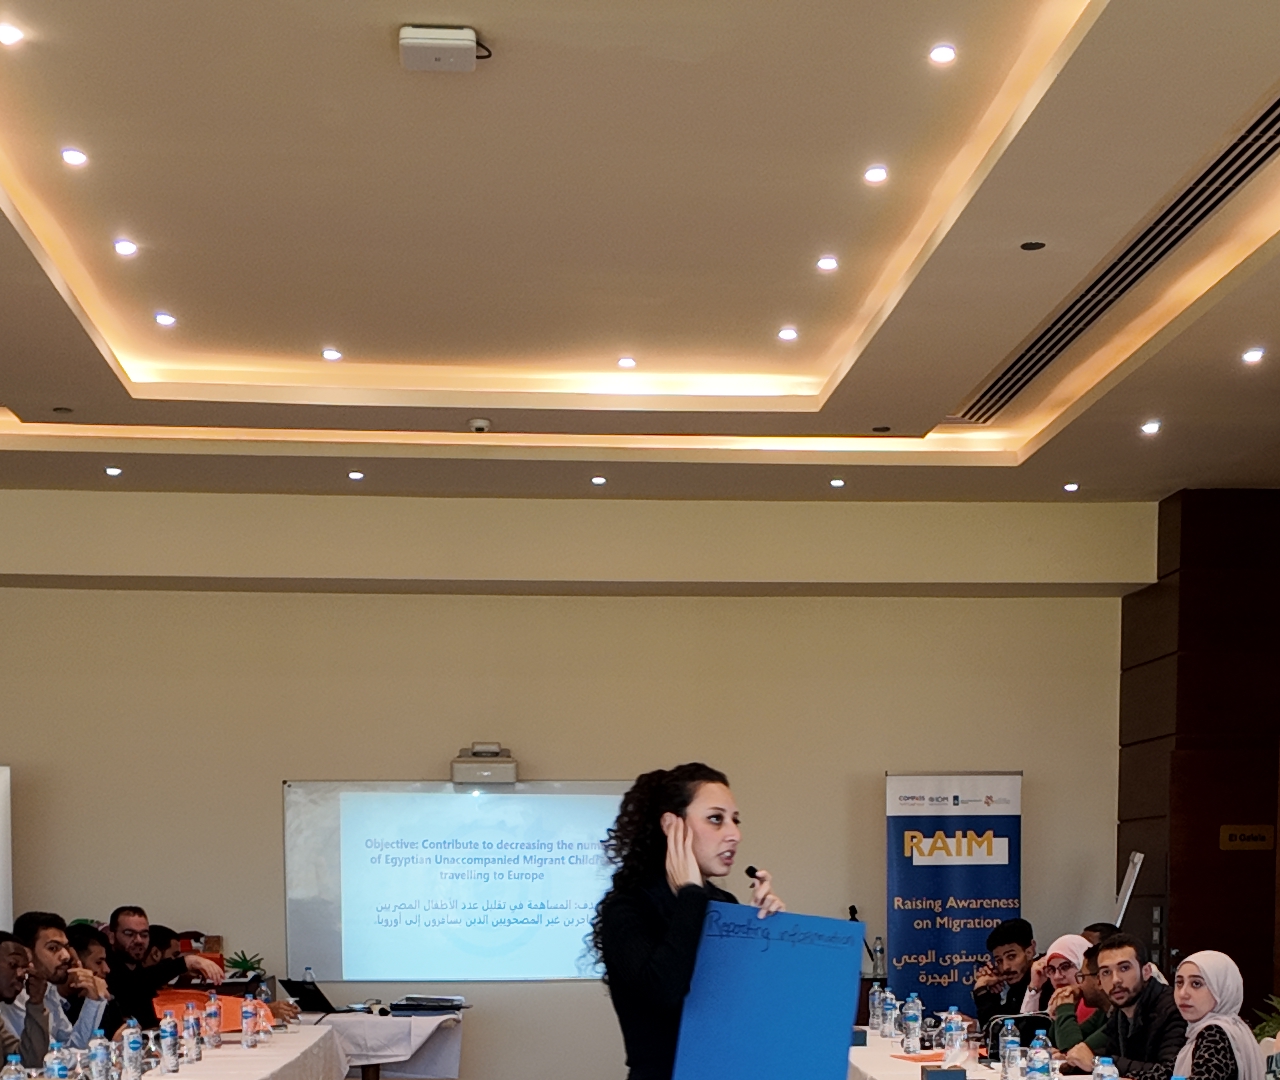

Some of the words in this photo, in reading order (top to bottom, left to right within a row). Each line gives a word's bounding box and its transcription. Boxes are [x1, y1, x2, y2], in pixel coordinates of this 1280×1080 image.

[364, 838, 419, 851] Objective:
[421, 838, 479, 850] Contribute
[482, 840, 494, 850] to
[496, 838, 553, 852] decreasing
[556, 839, 574, 850] the
[904, 830, 994, 858] RAIM
[370, 853, 382, 865] of
[384, 854, 432, 867] Egyptian
[434, 854, 520, 867] Unaccompanied
[523, 855, 566, 867] Migrant
[439, 869, 490, 882] travelling
[493, 871, 505, 880] to
[507, 870, 545, 882] Europe
[375, 899, 420, 913] المصريين
[423, 898, 458, 912] الأطفال
[461, 901, 479, 910] عدد
[482, 899, 507, 912] تقليل
[509, 900, 524, 913] في
[527, 899, 572, 910] المساهمة
[894, 896, 943, 913] Raising
[945, 896, 1020, 910] Awareness
[404, 913, 420, 927] إلى
[423, 913, 463, 927] يسافرون
[465, 914, 489, 927] الذين
[491, 914, 543, 927] المصحوبين
[544, 915, 561, 927] غير
[913, 920, 932, 930] on
[935, 917, 1002, 933] Migration
[892, 949, 936, 970] الوعي
[939, 949, 992, 967] مستوى
[918, 968, 959, 987] الهجرة
